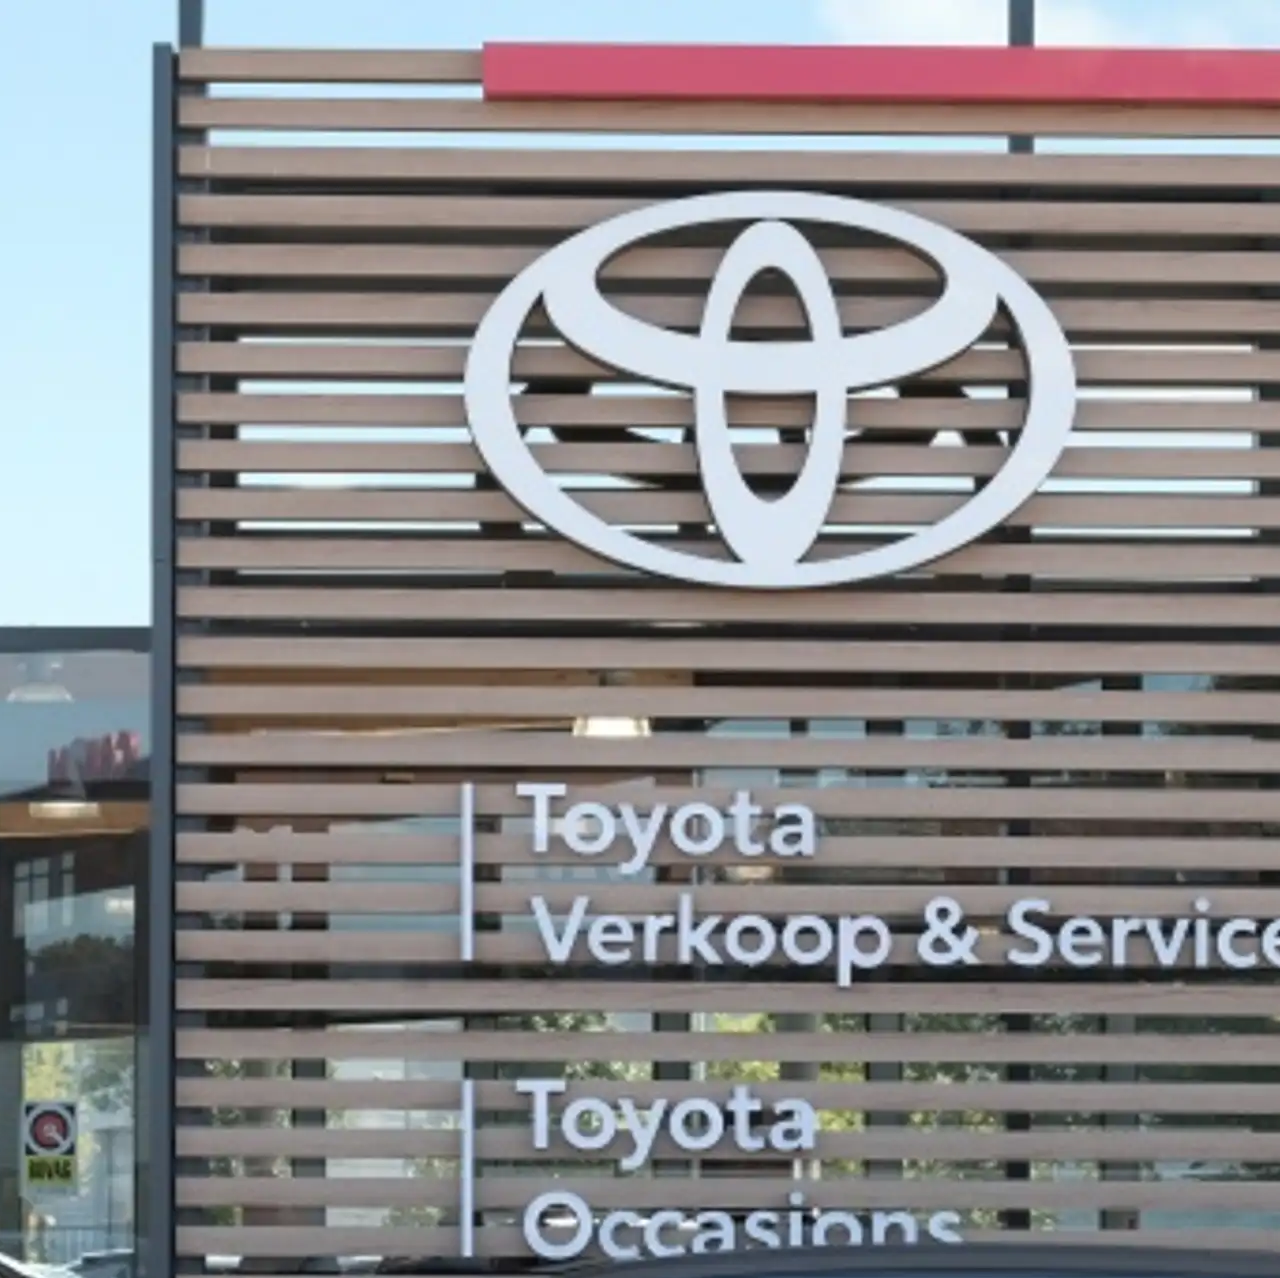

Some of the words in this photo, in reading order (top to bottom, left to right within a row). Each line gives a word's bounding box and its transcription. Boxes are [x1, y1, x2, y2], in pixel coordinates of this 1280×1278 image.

[516, 782, 818, 874] Toyota
[531, 894, 893, 984] Verkoop
[918, 895, 979, 966] &
[516, 1079, 816, 1169] Toyota
[523, 1190, 964, 1260] Occasions
